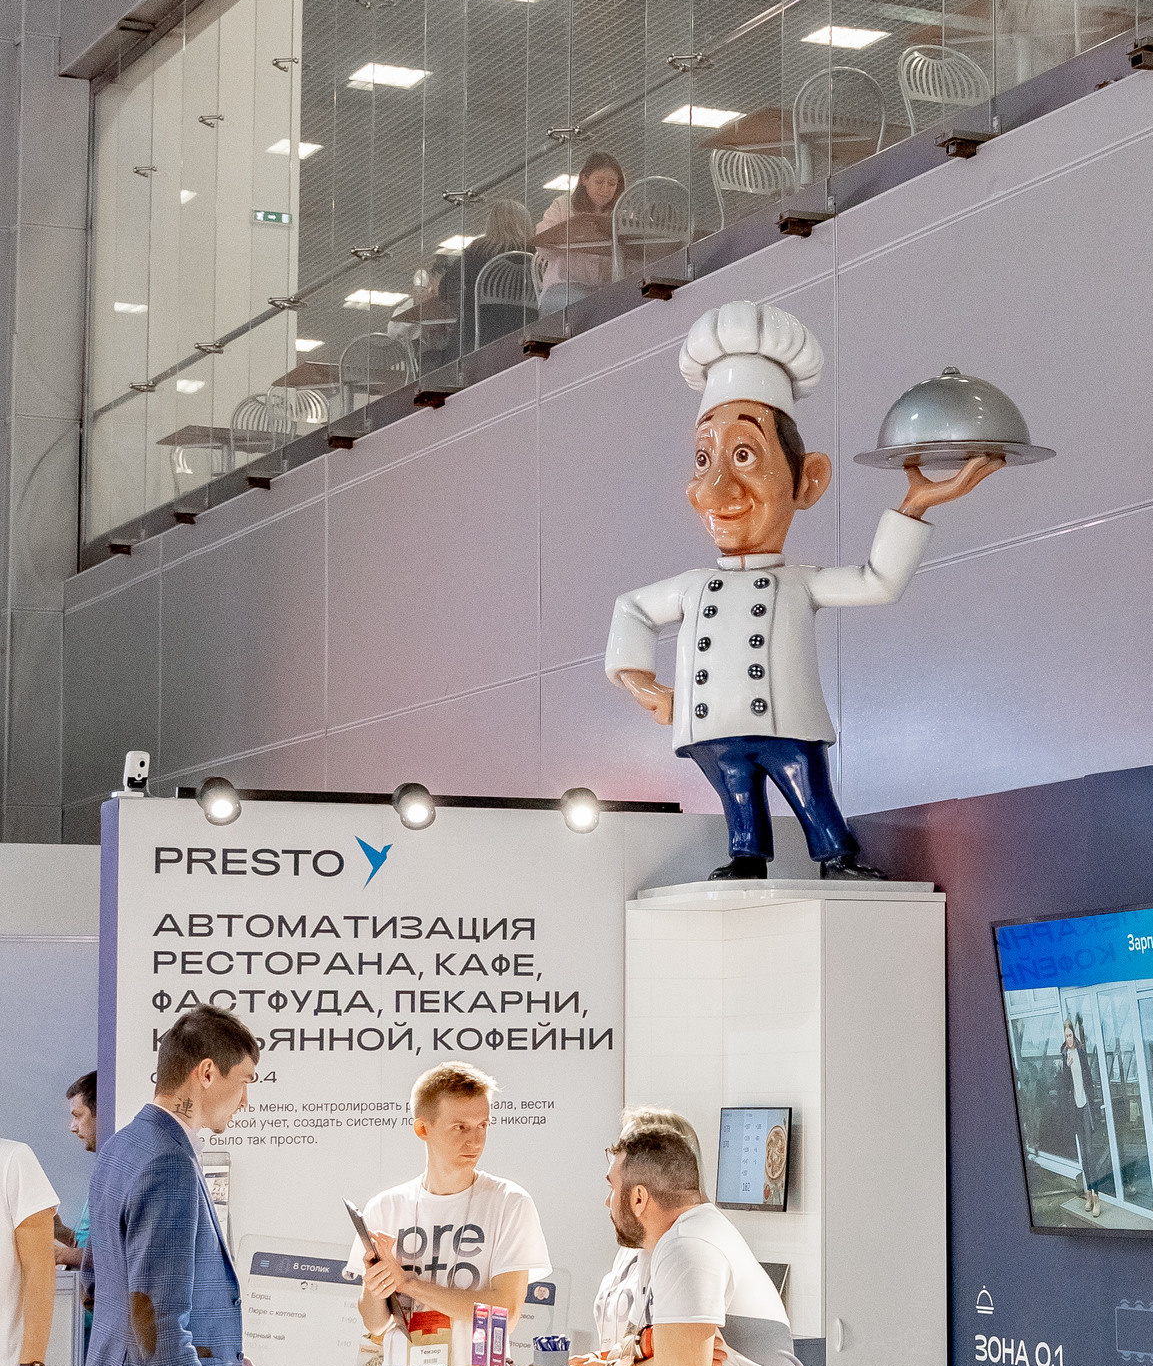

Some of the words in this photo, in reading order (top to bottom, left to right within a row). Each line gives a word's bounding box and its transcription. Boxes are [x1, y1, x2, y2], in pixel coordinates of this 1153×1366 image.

[154, 846, 345, 877] PRESTO
[152, 913, 536, 943] АВТОМАТИЗАЦИЯ
[153, 950, 424, 980] РЕСТОРАНА,
[435, 952, 543, 982] КАФЕ,
[152, 989, 383, 1018] ФАСТФУДА,
[395, 990, 588, 1019] ПЕКАРНИ,
[433, 1022, 614, 1051] КОФЕЙНИ
[260, 1103, 298, 1113] меню,
[302, 1101, 402, 1114] контролировать
[520, 1100, 555, 1110] вести
[260, 1119, 289, 1130] учет,
[293, 1118, 343, 1128] создать
[346, 1116, 397, 1129] систему
[501, 1115, 547, 1126] никогда
[209, 1135, 243, 1146] было
[247, 1136, 266, 1145] так
[270, 1135, 318, 1147] просто.
[396, 1223, 485, 1261] pre
[248, 1307, 267, 1315] Пюре
[251, 1292, 271, 1301] Борщ
[974, 1334, 1030, 1366] ЗОНА
